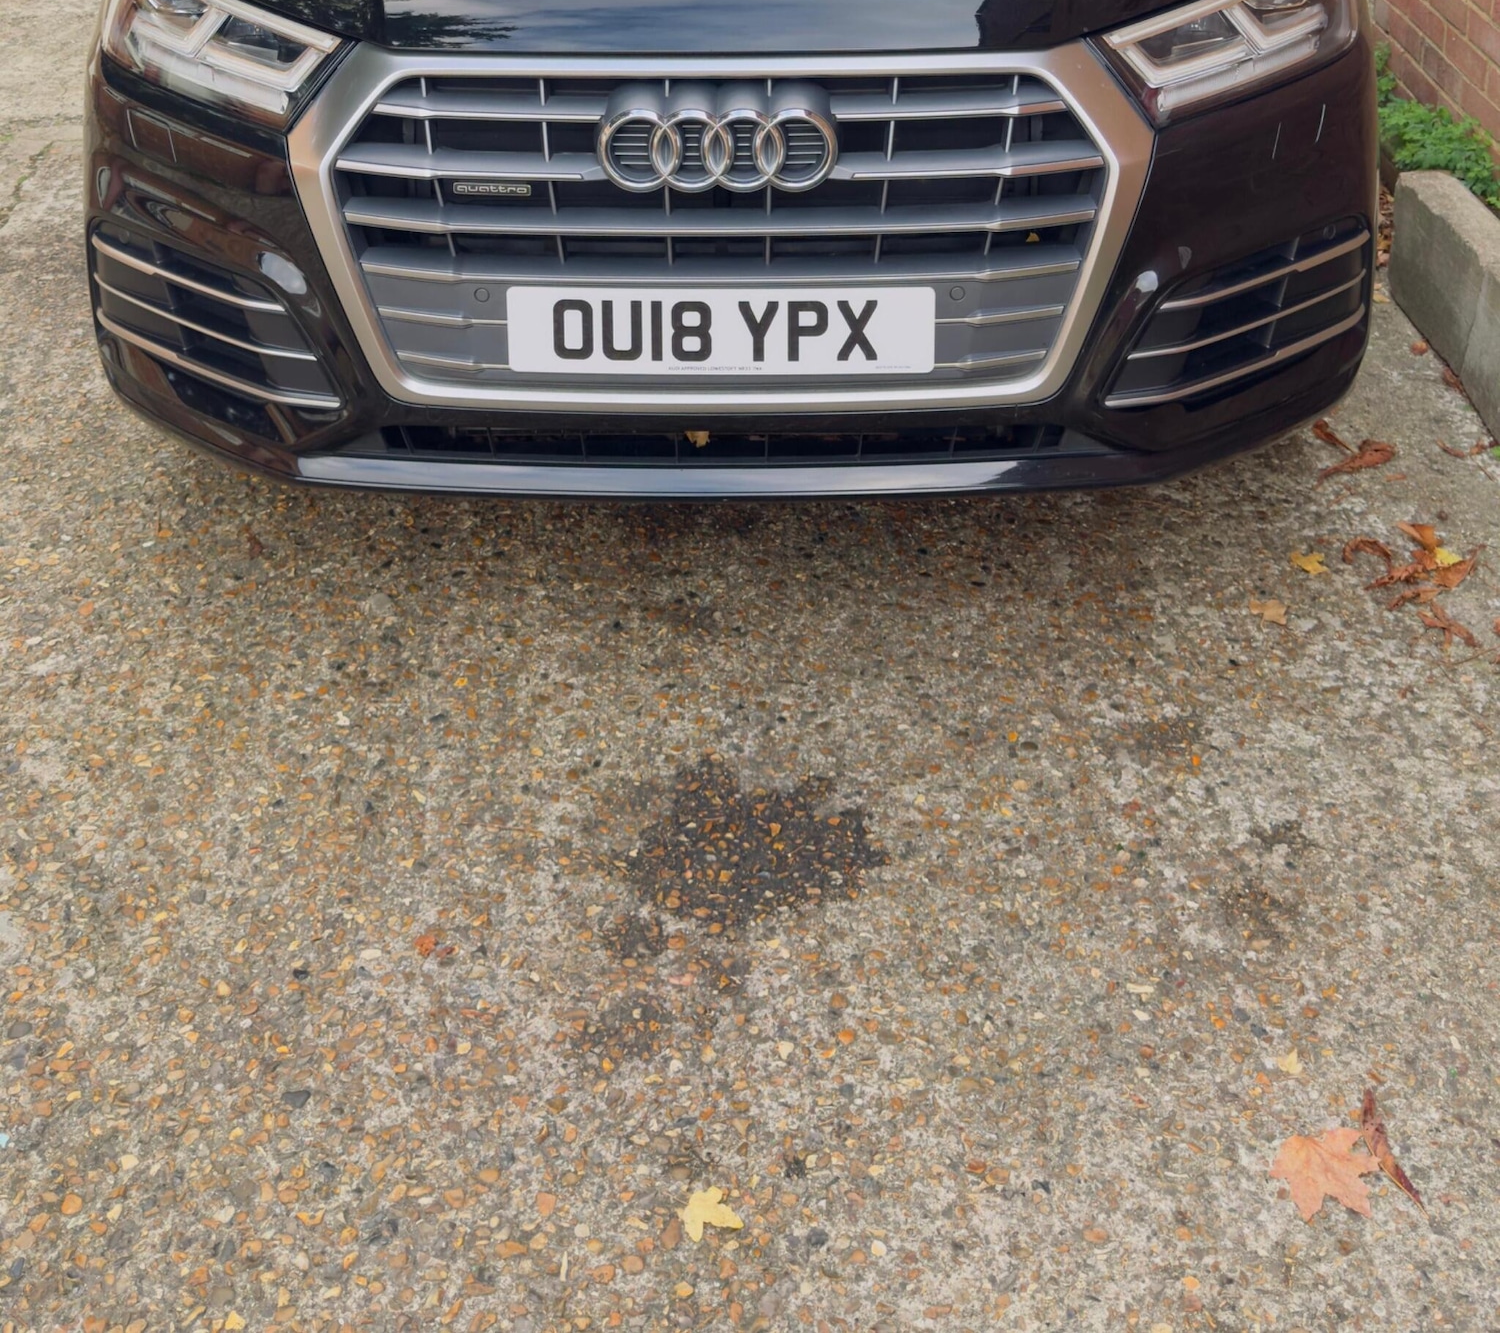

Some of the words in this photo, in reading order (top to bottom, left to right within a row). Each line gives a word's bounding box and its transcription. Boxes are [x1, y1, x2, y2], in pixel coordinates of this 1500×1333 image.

[456, 185, 528, 194] quattro
[552, 298, 713, 362] OU18
[737, 300, 878, 362] YPX
